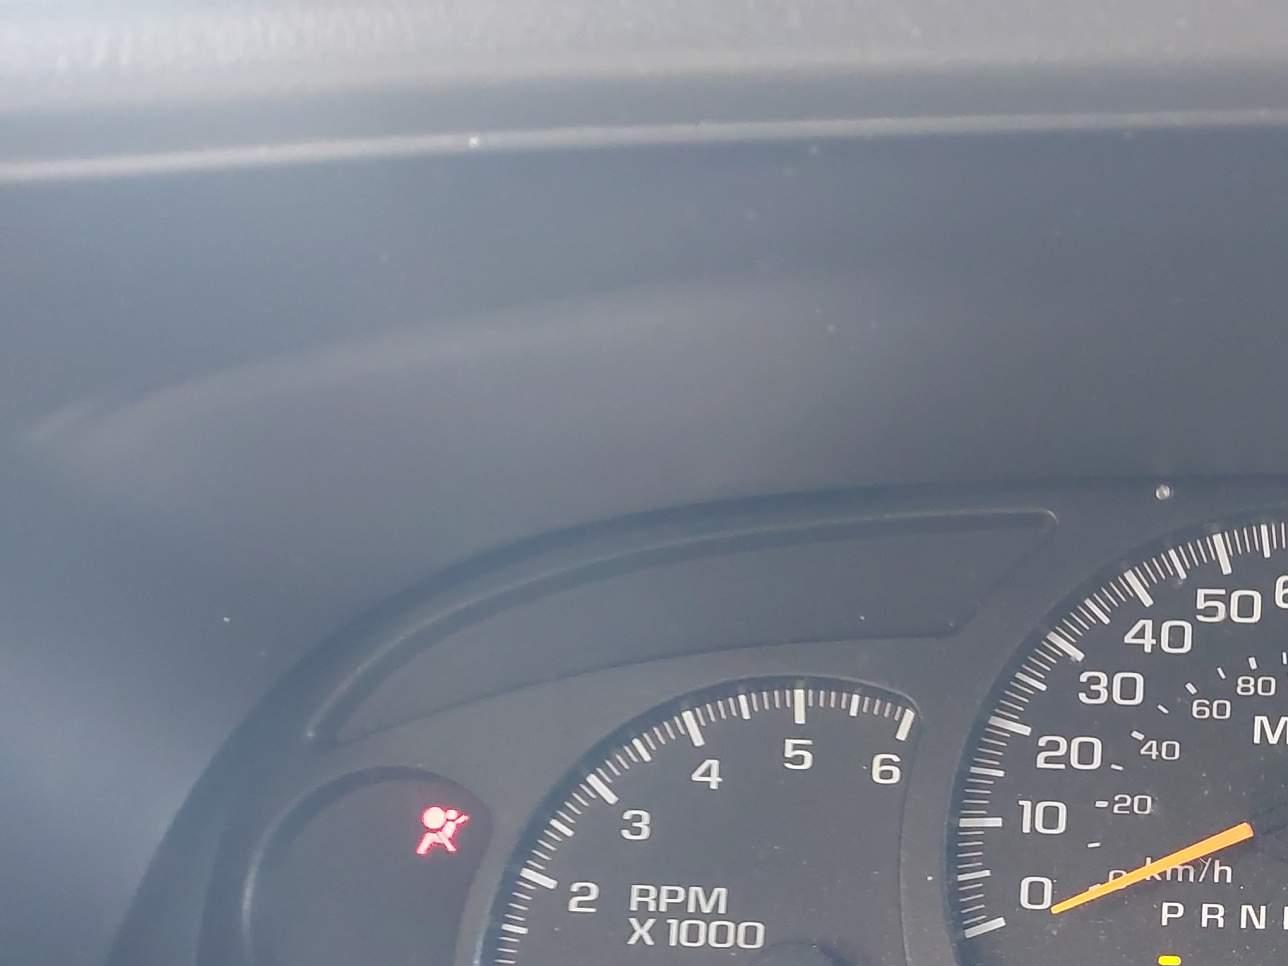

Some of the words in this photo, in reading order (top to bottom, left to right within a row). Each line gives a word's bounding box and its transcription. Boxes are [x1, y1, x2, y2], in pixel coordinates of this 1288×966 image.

[1195, 588, 1262, 624] 50
[1123, 619, 1193, 654] 40
[1077, 671, 1145, 706] 30
[1236, 675, 1277, 697] 80
[1191, 699, 1232, 720] 60
[783, 739, 814, 770] 5
[1036, 735, 1103, 771] 20
[1140, 739, 1181, 760] 40
[691, 759, 723, 790] 4
[871, 754, 901, 784] 6
[1017, 799, 1068, 835] 10
[1112, 795, 1152, 815] 20
[621, 809, 651, 840] 3
[568, 882, 599, 913] 2
[629, 884, 728, 914] RPM
[1019, 876, 1052, 911] 0
[627, 918, 654, 946] X
[666, 918, 766, 949] 1000
